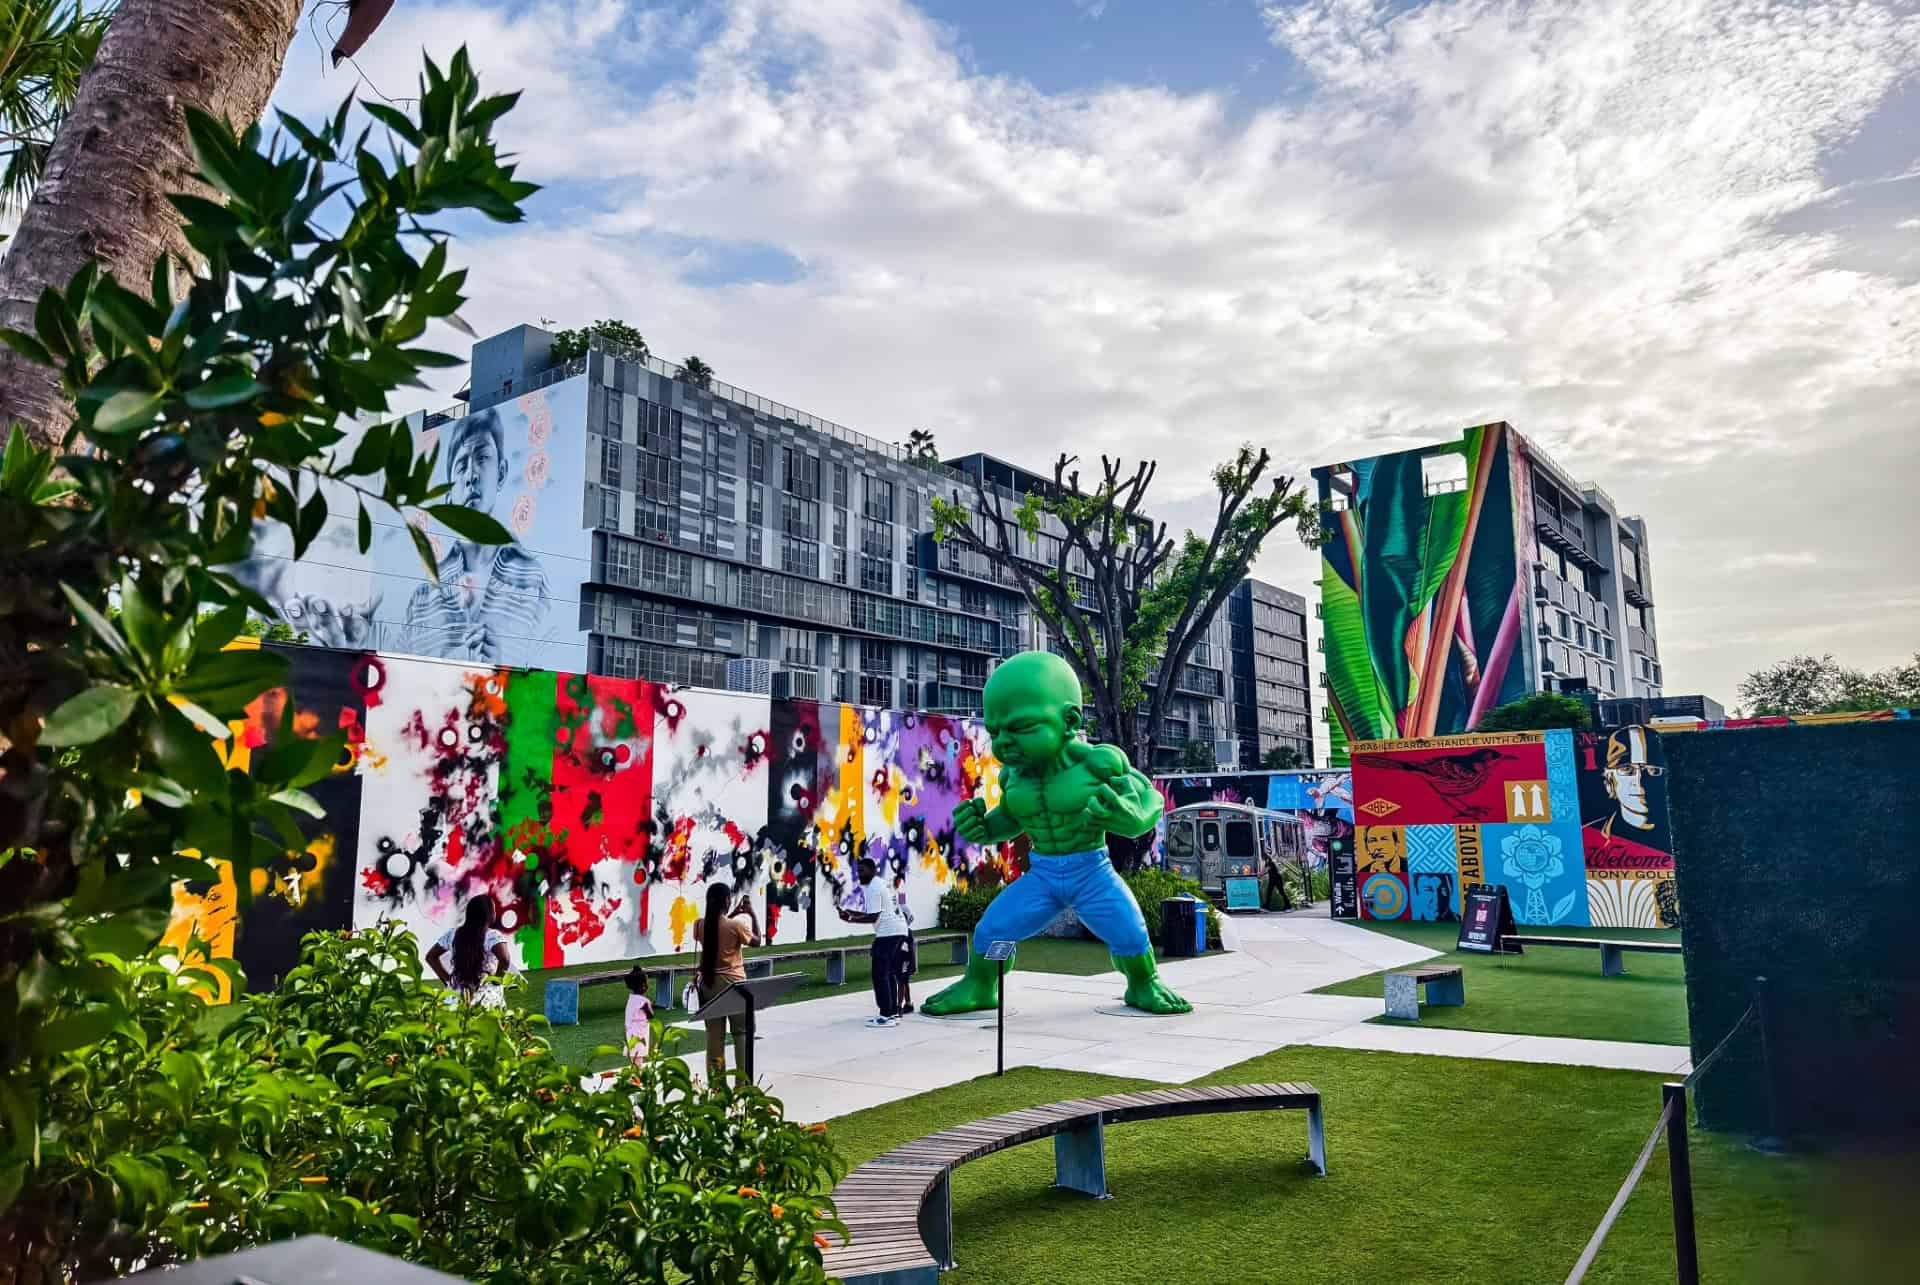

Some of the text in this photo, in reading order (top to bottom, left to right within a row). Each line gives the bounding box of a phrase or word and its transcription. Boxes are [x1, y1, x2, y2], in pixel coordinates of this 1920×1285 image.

[1482, 736, 1510, 745] WITH
[1512, 735, 1537, 744] CARE
[1584, 748, 1598, 770] 1
[1459, 825, 1480, 878] ABOVE
[1586, 846, 1672, 868] Welcome
[1590, 871, 1629, 879] TONY
